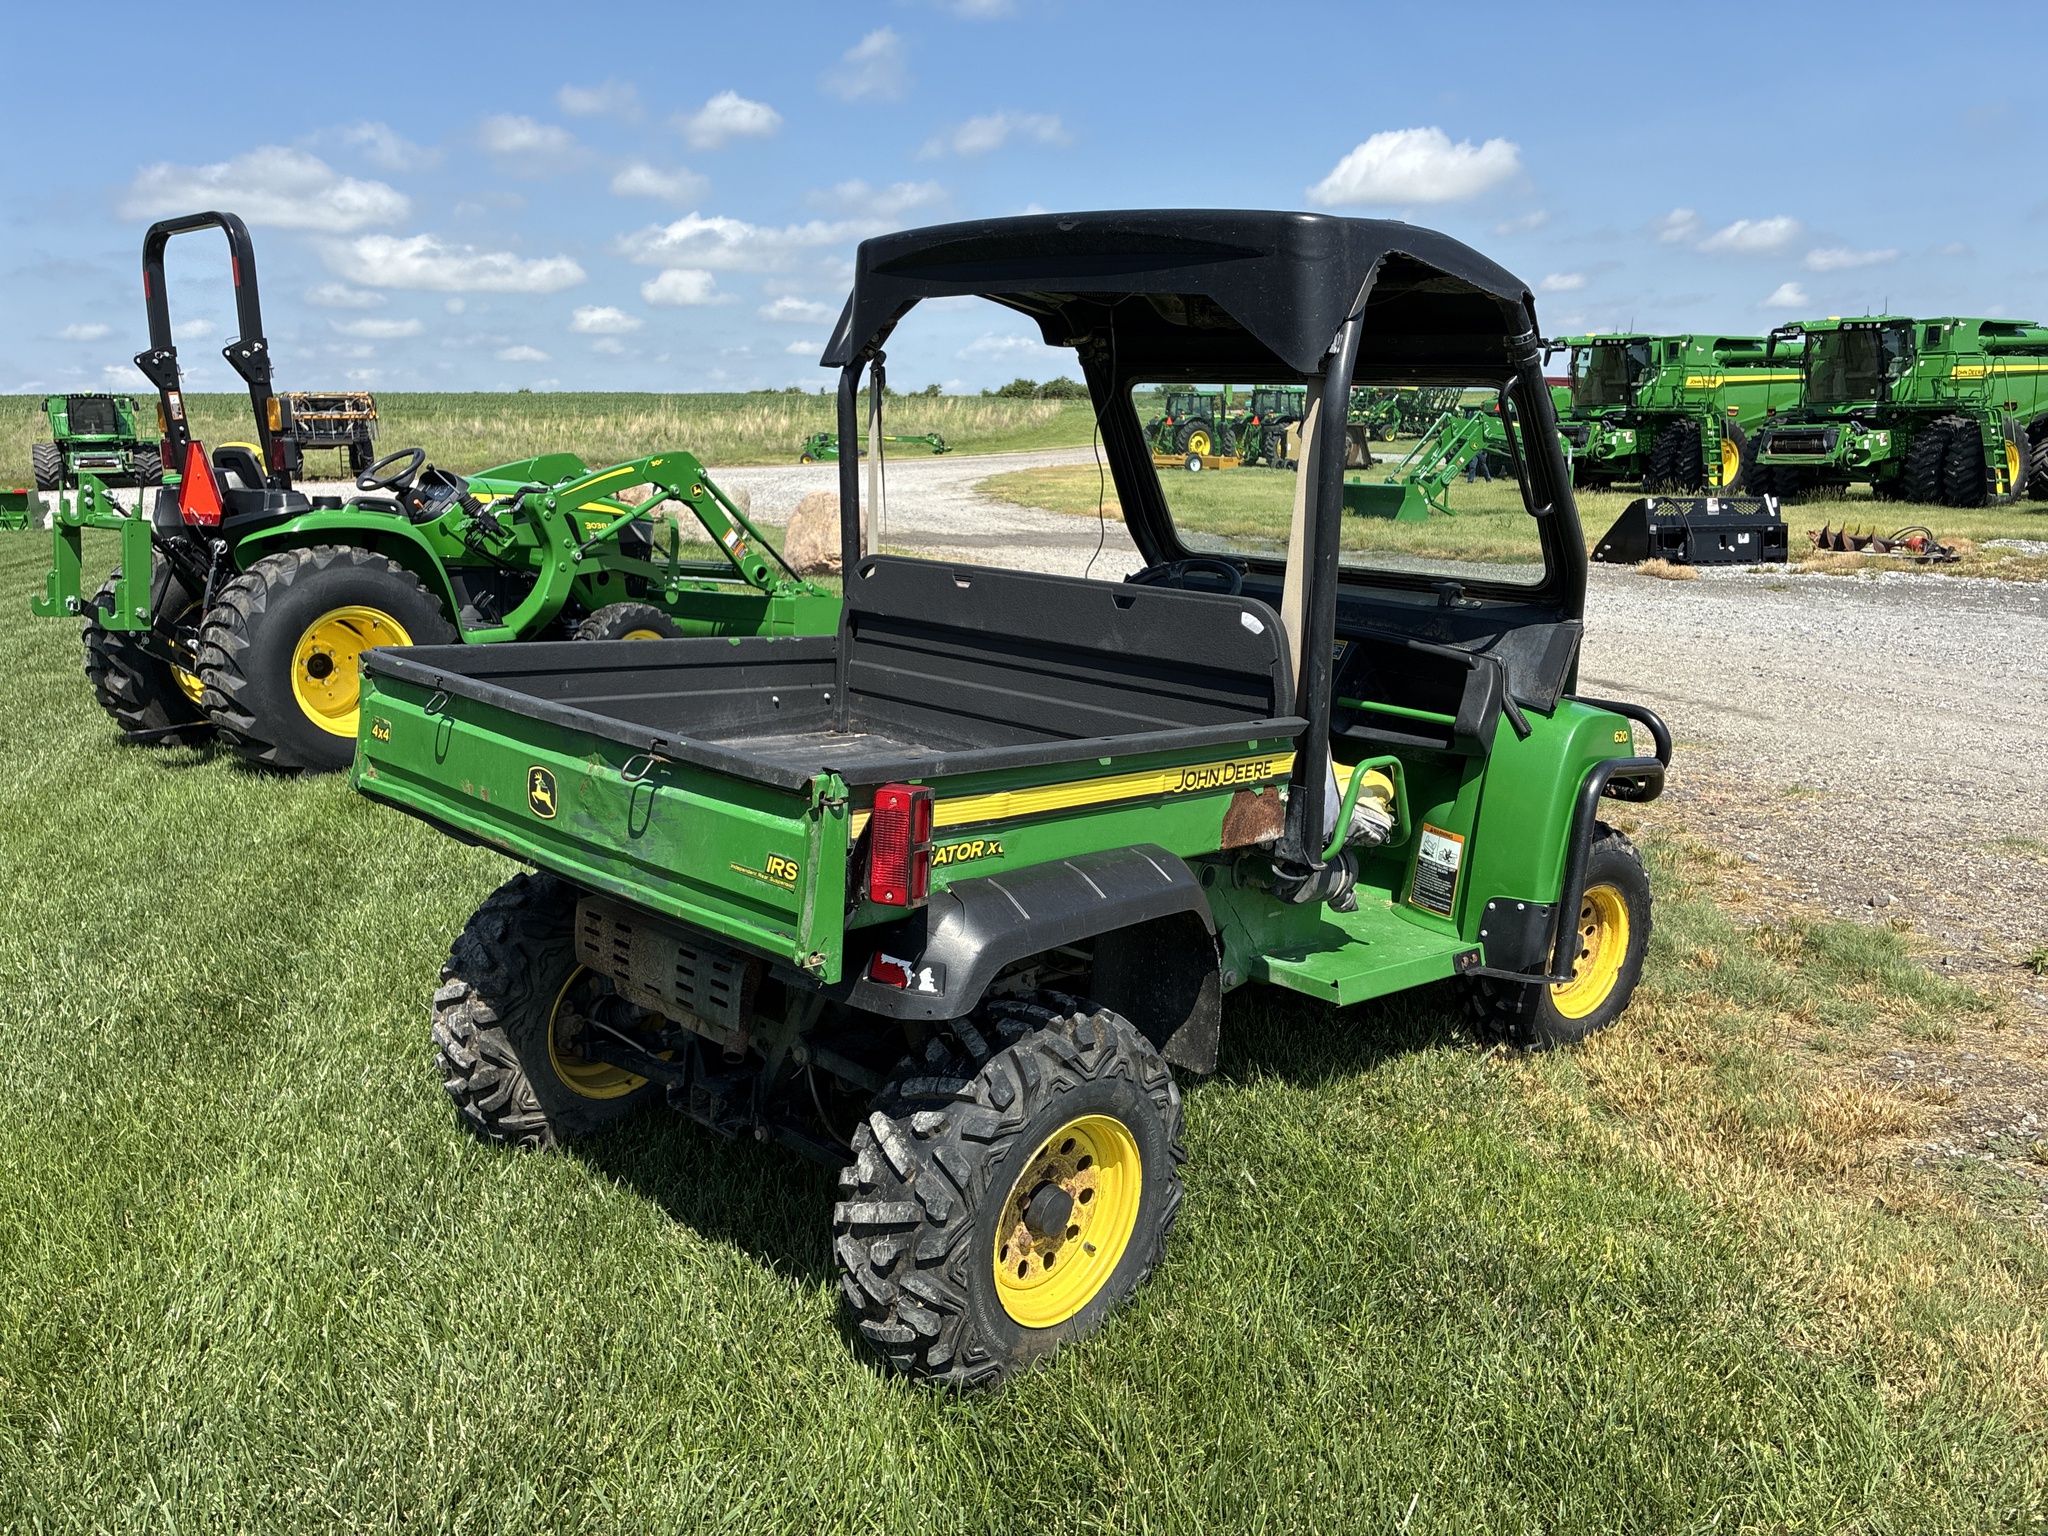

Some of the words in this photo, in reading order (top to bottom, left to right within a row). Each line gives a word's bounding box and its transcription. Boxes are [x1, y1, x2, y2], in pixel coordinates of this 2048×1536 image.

[1614, 730, 1628, 743] 620
[1174, 768, 1220, 790] JOHN
[1223, 760, 1273, 782] DEERE
[766, 855, 799, 881] IRS
